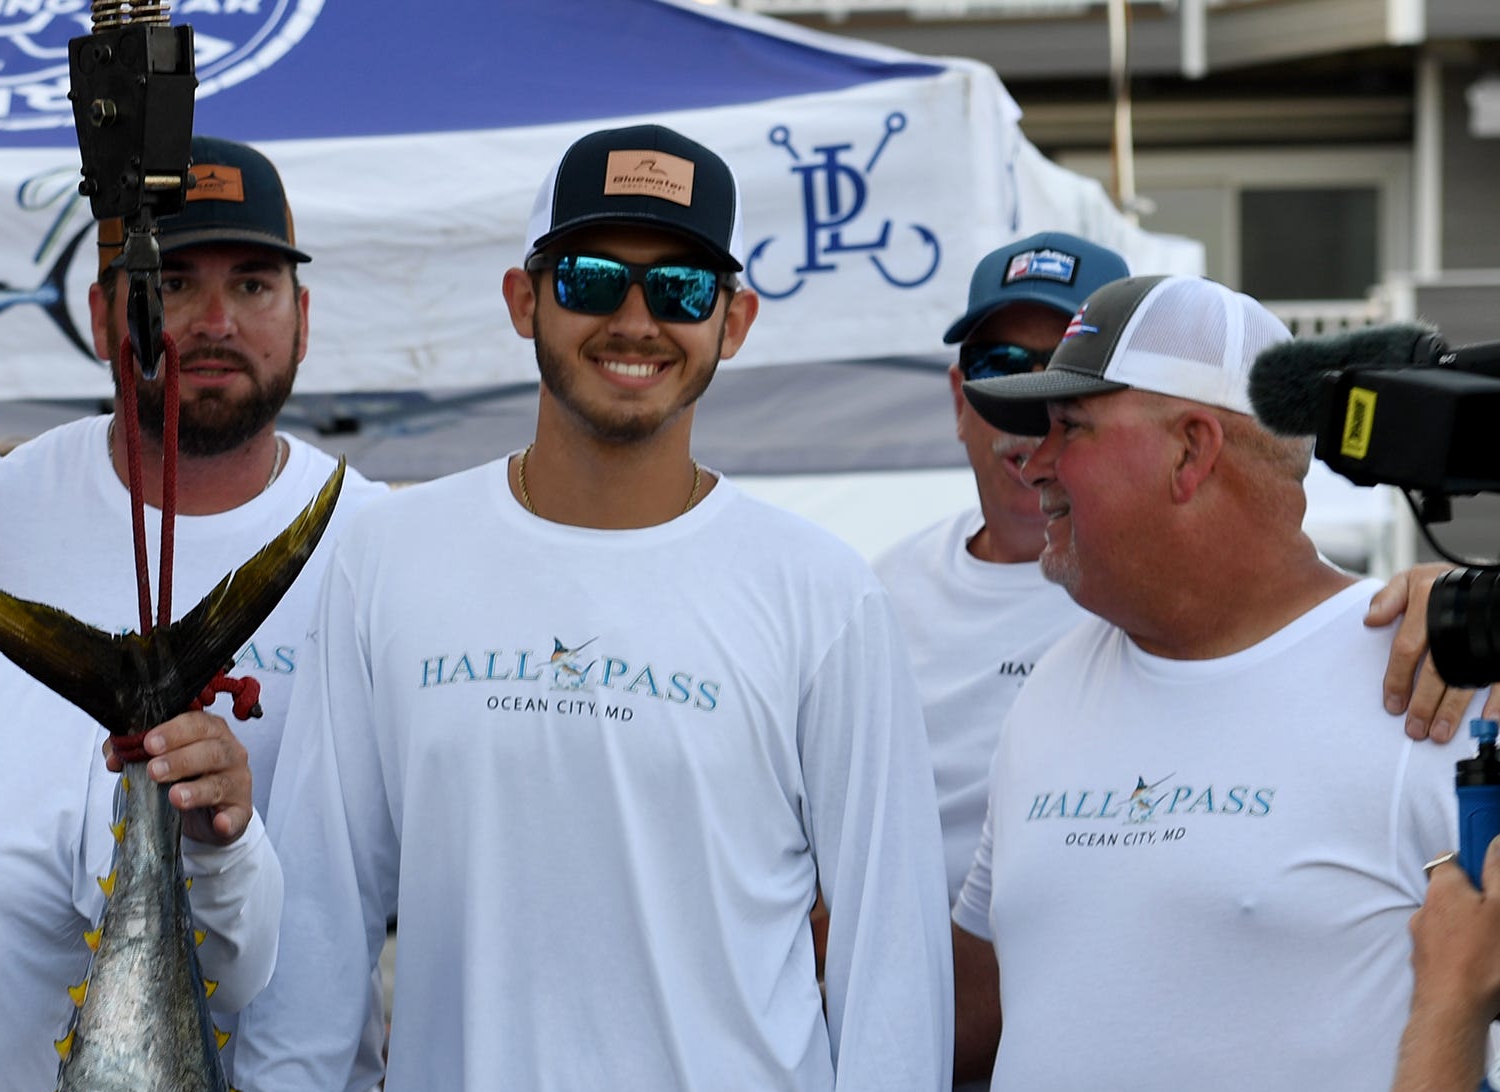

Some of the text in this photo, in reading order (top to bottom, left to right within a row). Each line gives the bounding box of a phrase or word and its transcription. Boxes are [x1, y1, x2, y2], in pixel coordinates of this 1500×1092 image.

[419, 649, 721, 712] HALL PASS
[486, 696, 633, 722] OCEAN CITY, MD
[1026, 784, 1276, 823] HALL PASS
[1065, 827, 1187, 846] OCEAN CITY, MD
